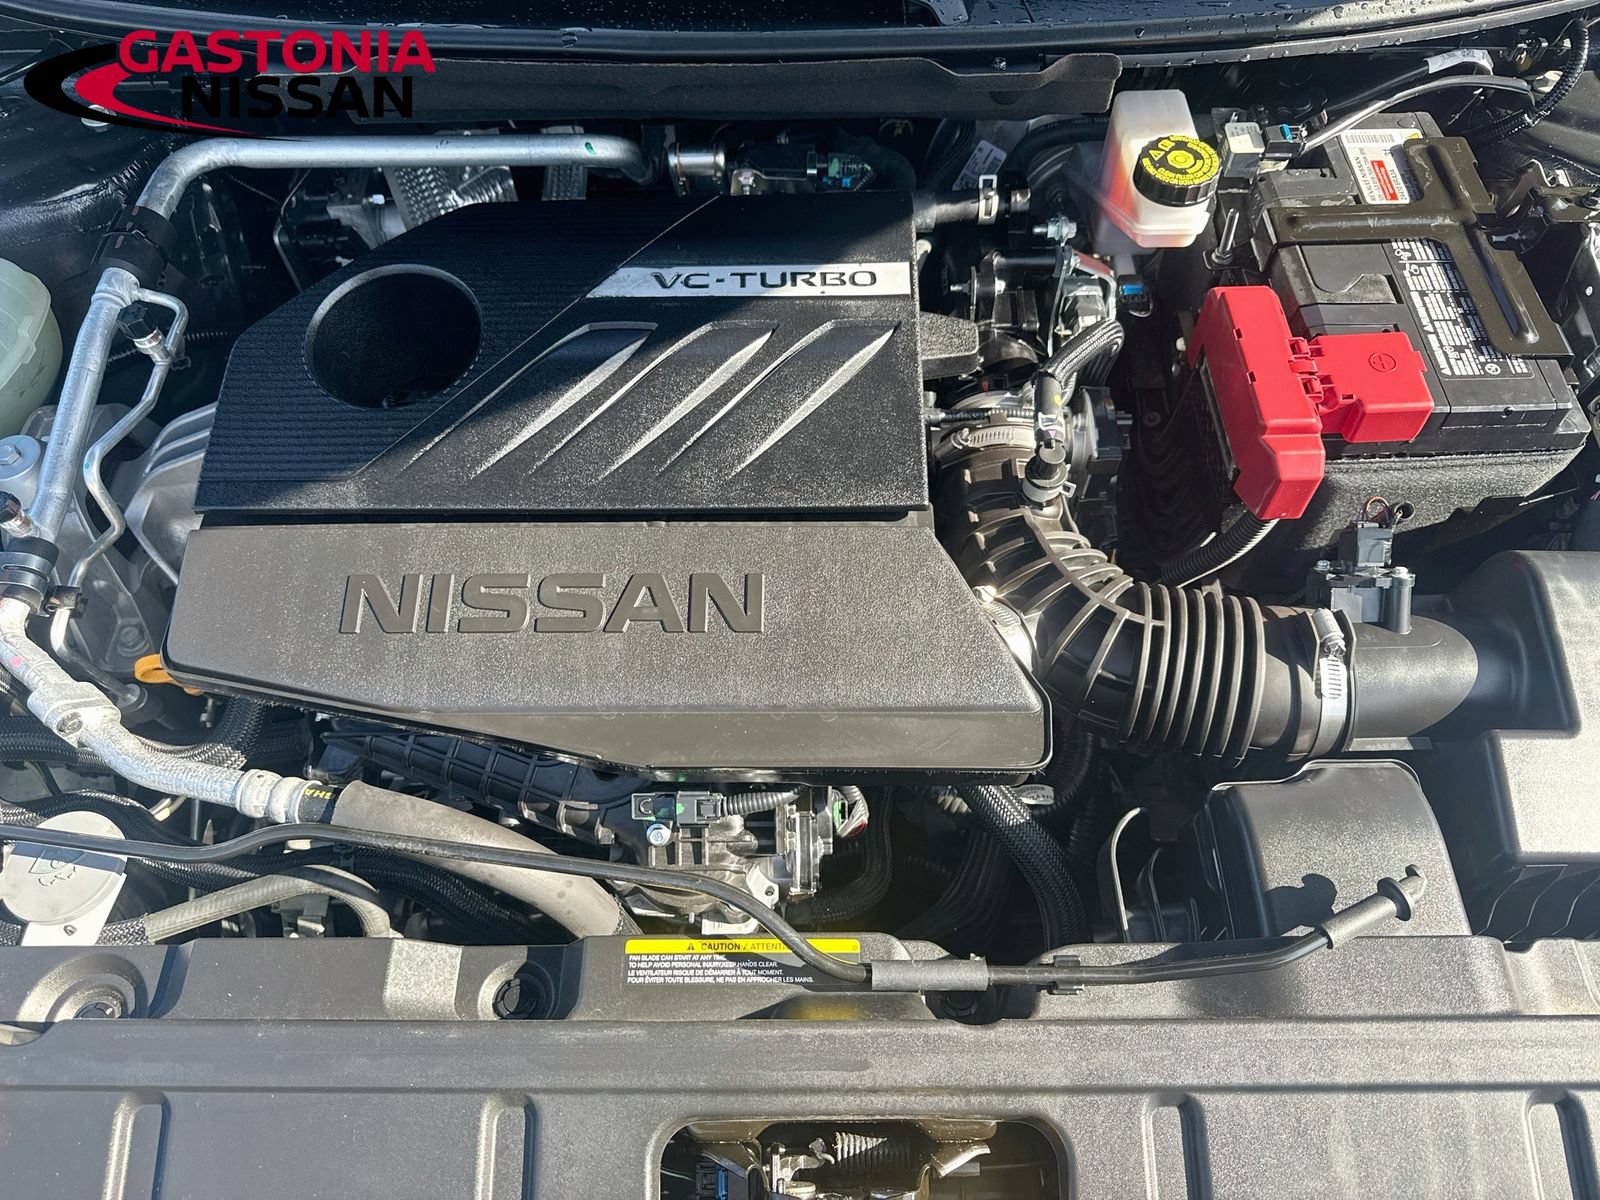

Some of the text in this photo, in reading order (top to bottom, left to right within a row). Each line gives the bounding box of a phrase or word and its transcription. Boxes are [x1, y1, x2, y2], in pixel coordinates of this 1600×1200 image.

[651, 270, 877, 289] VC-TURBO
[339, 573, 764, 633] NISSAN
[701, 943, 740, 951] CAUTION
[705, 967, 735, 976] DÉMARRER
[645, 975, 664, 983] ÉVITER
